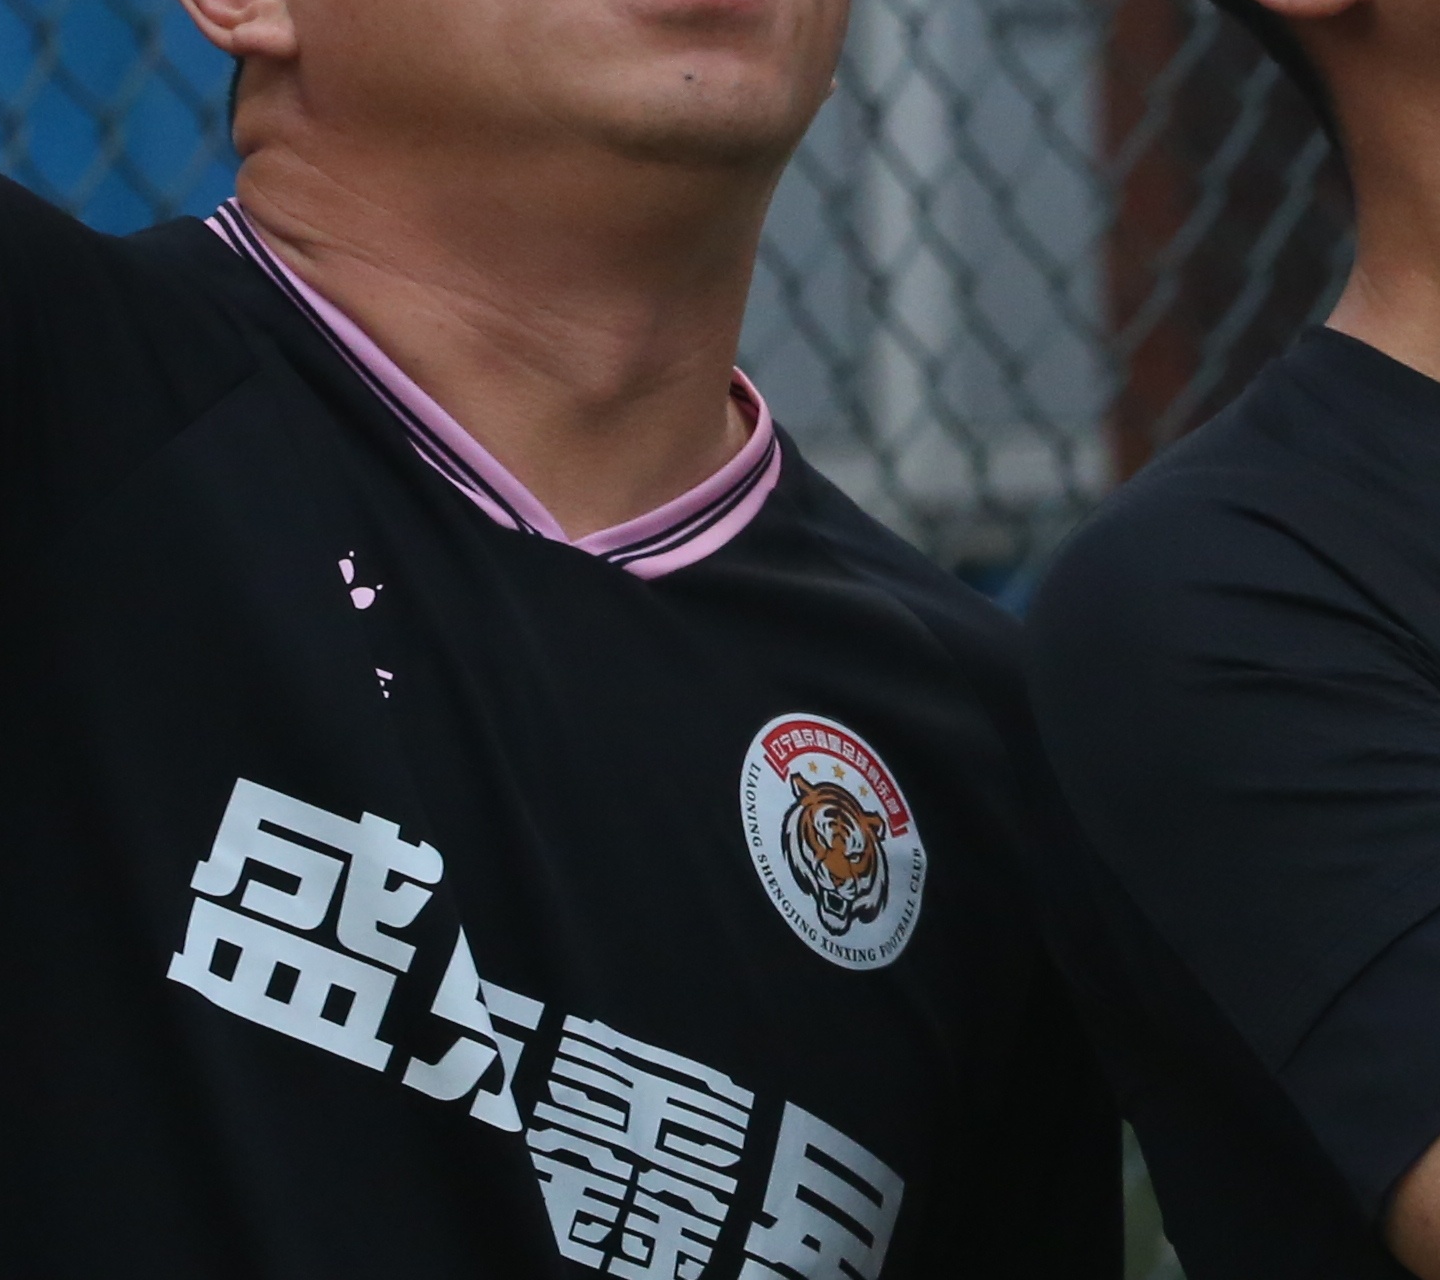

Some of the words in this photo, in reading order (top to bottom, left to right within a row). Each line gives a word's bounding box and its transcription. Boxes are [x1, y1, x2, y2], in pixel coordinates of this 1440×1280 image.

[745, 762, 762, 848] LIAONING
[757, 853, 818, 942] SHENGJING
[820, 935, 877, 963] XINXING
[879, 898, 917, 959] FOOTBALL
[909, 847, 923, 894] CLUB
